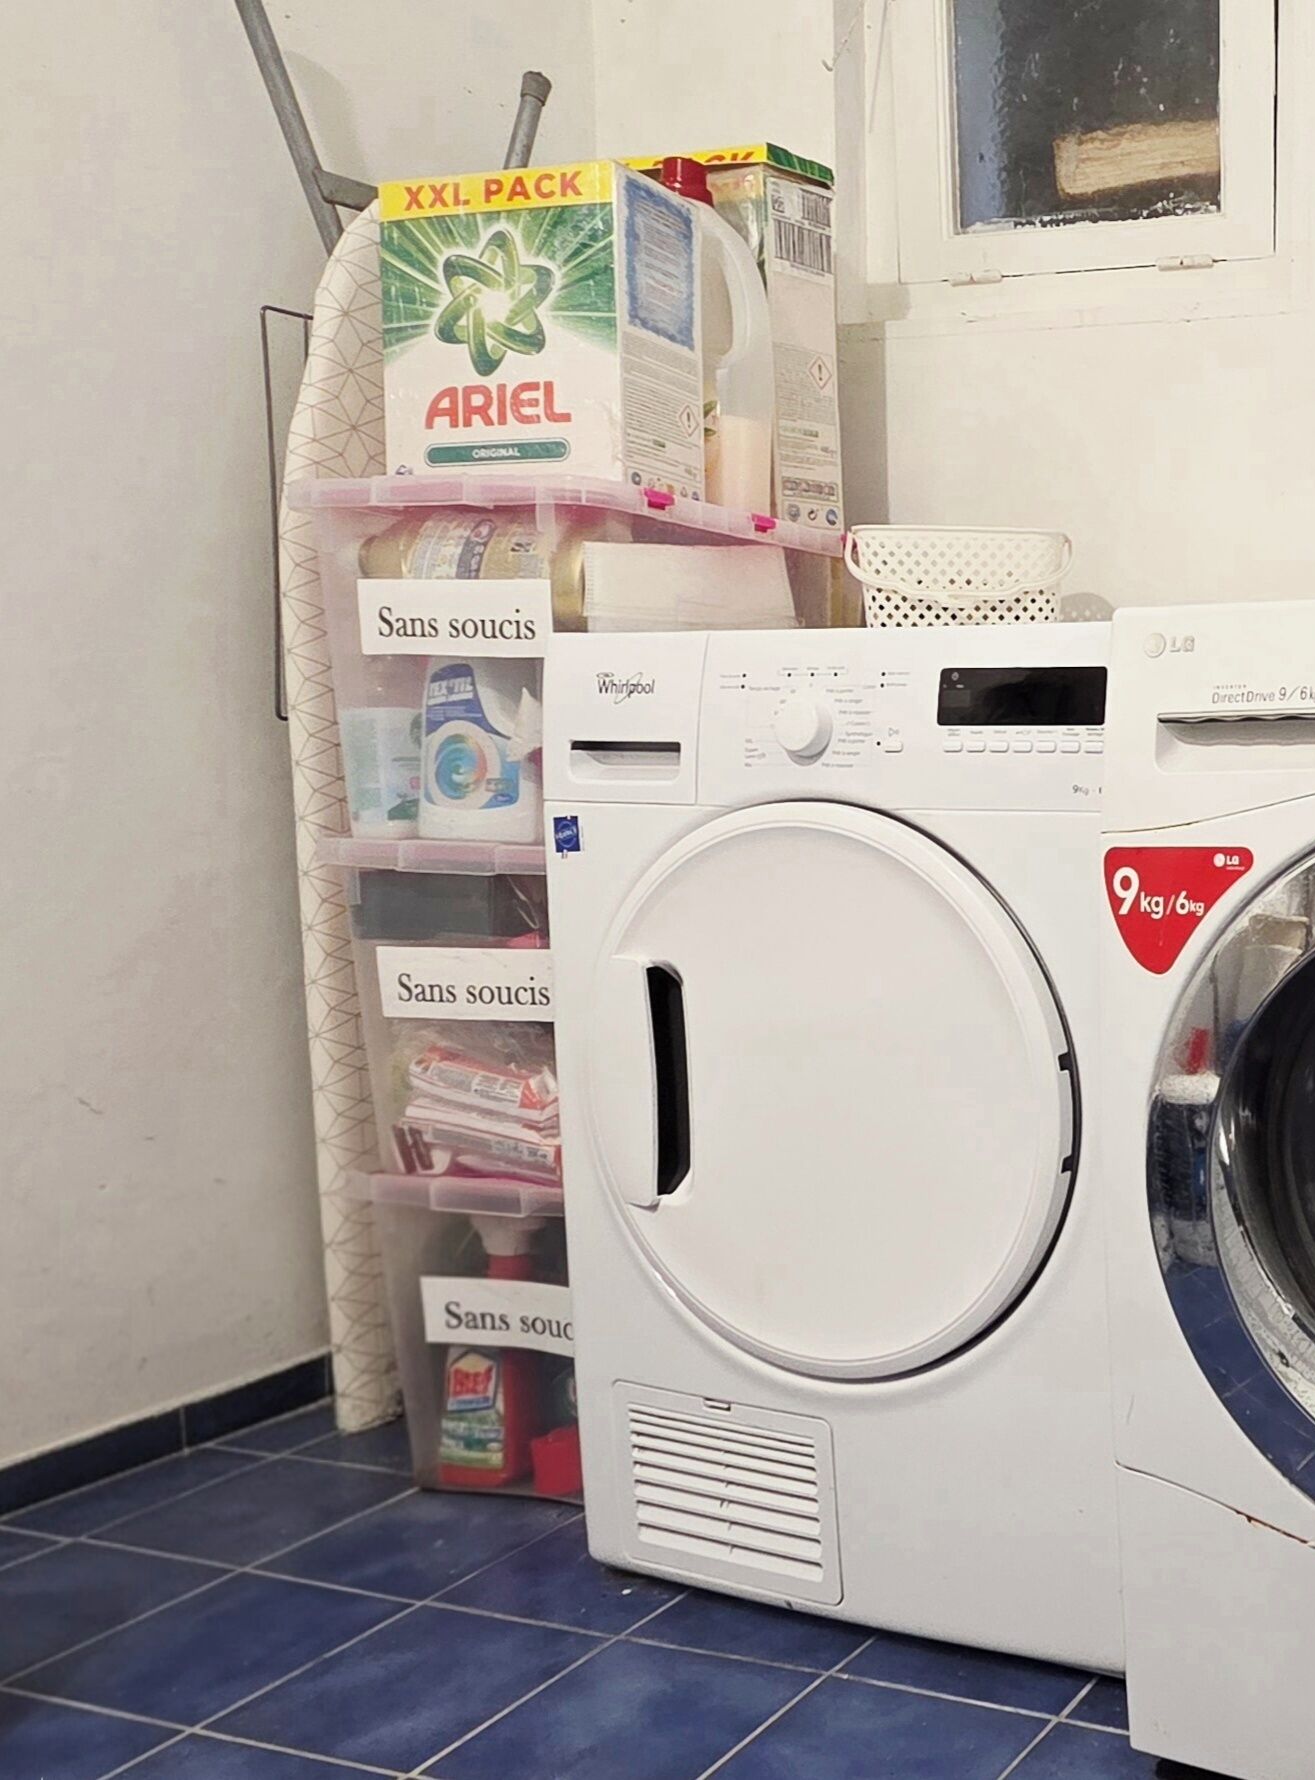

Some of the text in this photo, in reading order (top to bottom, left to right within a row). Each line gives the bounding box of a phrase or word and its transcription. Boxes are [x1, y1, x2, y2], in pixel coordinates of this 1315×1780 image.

[404, 170, 583, 212] XXL PACK
[425, 381, 572, 430] ARIEL
[472, 446, 521, 459] ORIGINAL
[378, 606, 536, 641] Sans soucis
[597, 674, 655, 702] Whirlpool
[1226, 855, 1240, 866] LG
[397, 972, 551, 1007] Sans soucis
[444, 1300, 510, 1333] Sans
